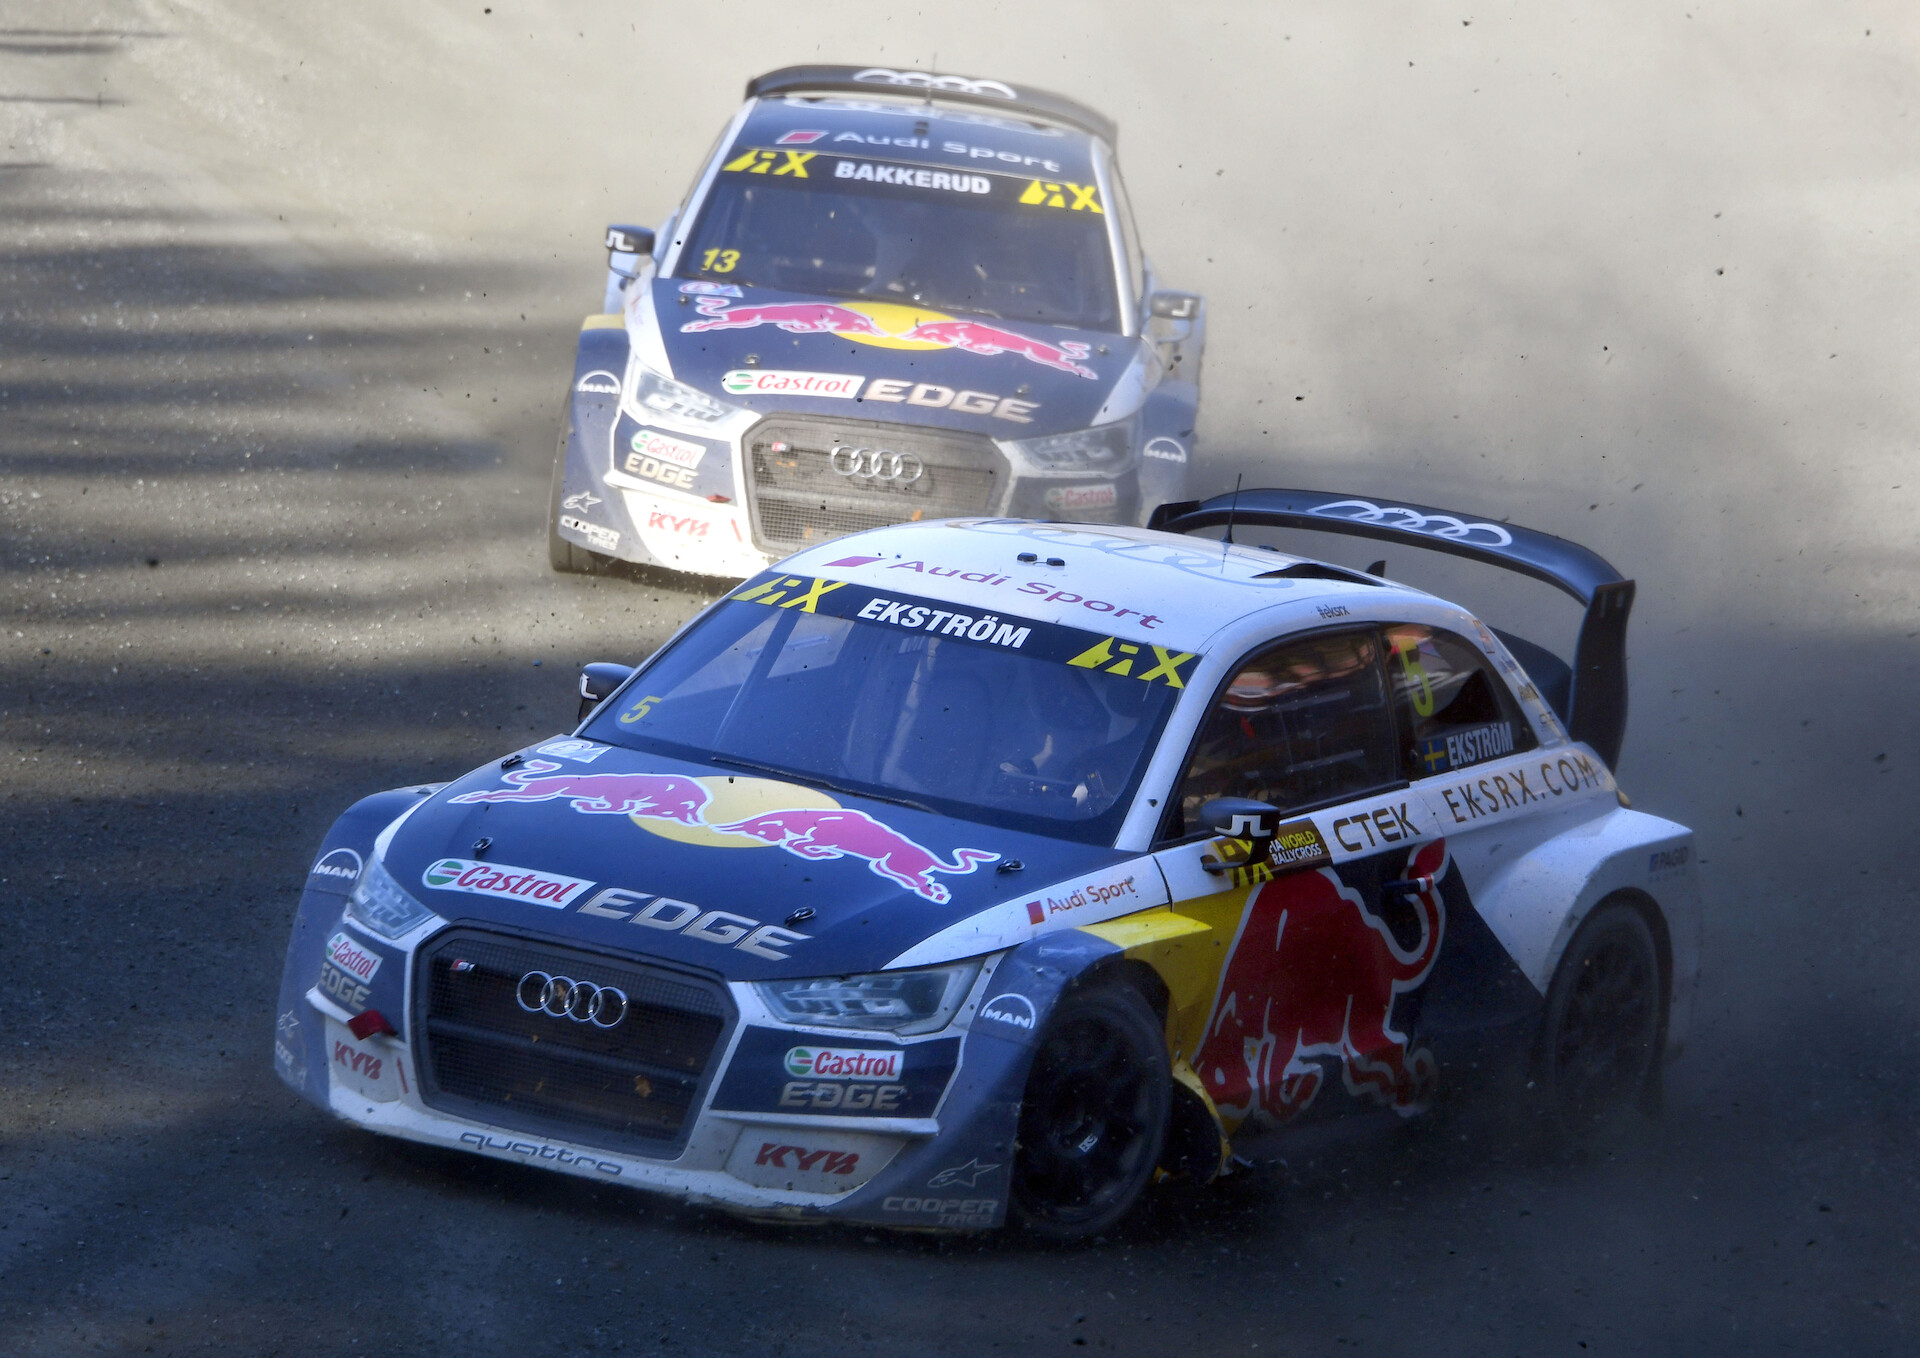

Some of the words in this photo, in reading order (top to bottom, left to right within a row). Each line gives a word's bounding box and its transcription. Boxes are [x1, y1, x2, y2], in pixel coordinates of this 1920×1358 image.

[833, 131, 929, 149] Audi
[943, 141, 1060, 173] Sport
[834, 161, 991, 194] BAKKERUD
[701, 248, 741, 273] 13
[757, 374, 851, 394] Castrol
[864, 378, 1041, 423] EDGE
[646, 438, 697, 464] Castrol
[624, 452, 699, 489] EDGE
[1065, 487, 1113, 506] Castrol
[561, 515, 621, 542] COOPER
[648, 512, 710, 536] KYB
[887, 559, 1012, 587] Audi
[1016, 581, 1164, 631] Sport
[856, 598, 1032, 649] EKSTRÖM
[1400, 637, 1433, 717] 5
[620, 695, 662, 723] 5
[1446, 721, 1514, 767] EKSTRÖM
[1333, 802, 1421, 852] CTEK
[1442, 754, 1599, 824] EKSRX.COM
[315, 864, 358, 880] MAN
[1271, 843, 1323, 866] RALLYCROSS
[1047, 888, 1087, 914] Audi
[1086, 876, 1136, 905] Sport
[457, 865, 579, 903] Castrol
[577, 887, 815, 962] EDGE
[333, 942, 379, 979] Castrol
[320, 961, 371, 1011] EDGE
[984, 1008, 1031, 1028] MAN
[334, 1040, 383, 1080] KYB
[814, 1051, 896, 1077] Castrol
[778, 1081, 908, 1110] EDGE
[459, 1132, 623, 1176] quattro
[755, 1143, 860, 1175] KYB
[881, 1196, 998, 1214] COOPER
